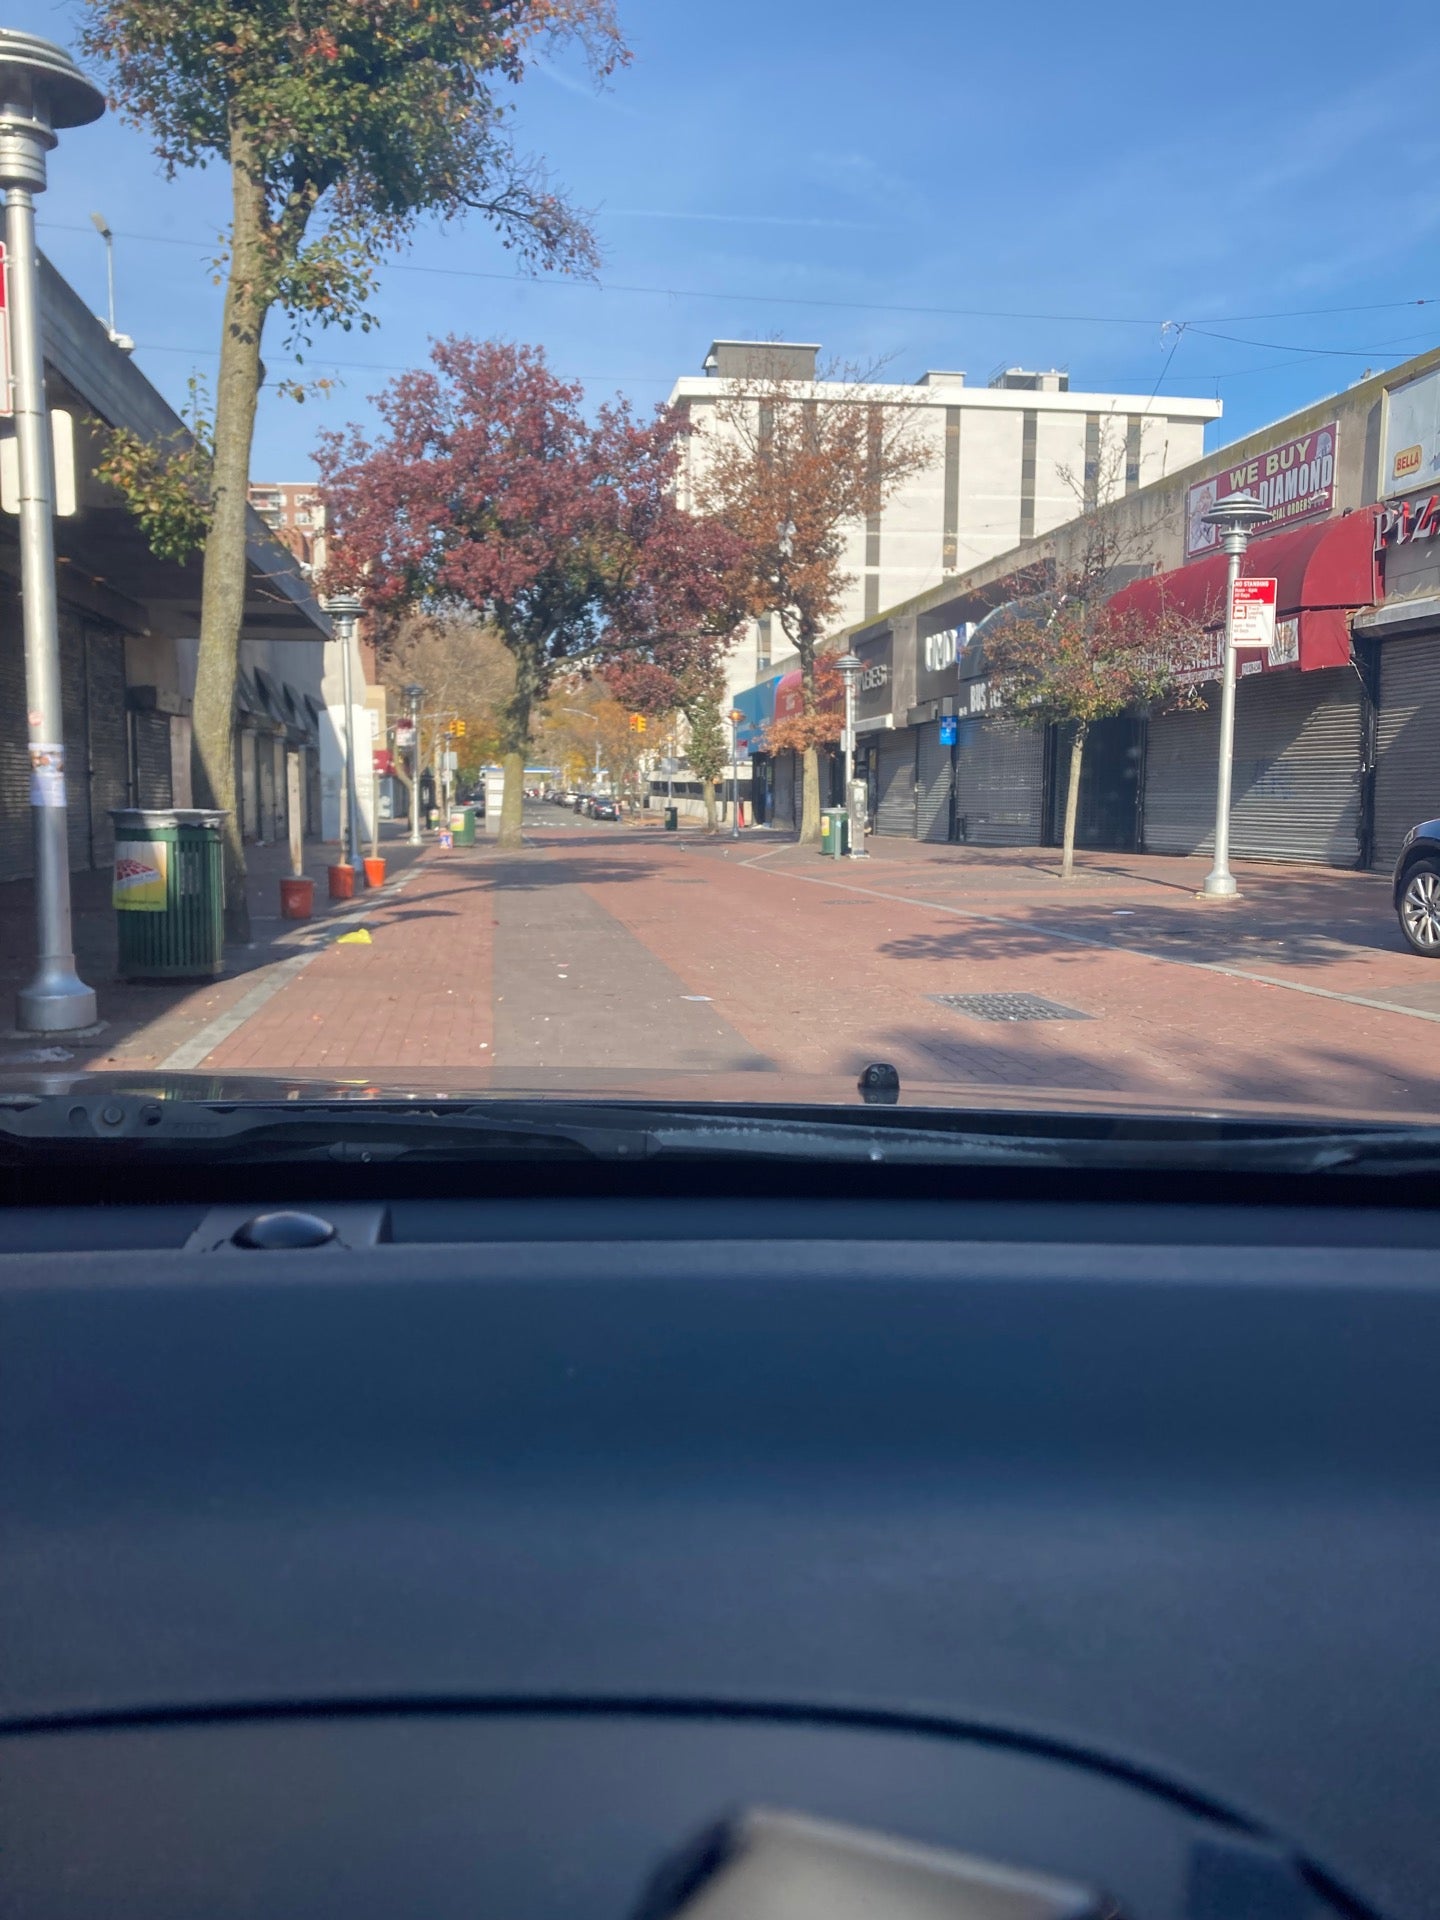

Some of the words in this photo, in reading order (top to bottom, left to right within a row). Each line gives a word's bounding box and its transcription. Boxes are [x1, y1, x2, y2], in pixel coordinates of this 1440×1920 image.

[1229, 461, 1259, 491] WE
[1266, 438, 1312, 476] BUY
[1396, 452, 1419, 471] BELLA
[1259, 454, 1333, 509] DIAMOND
[1287, 497, 1312, 516] ORDERS
